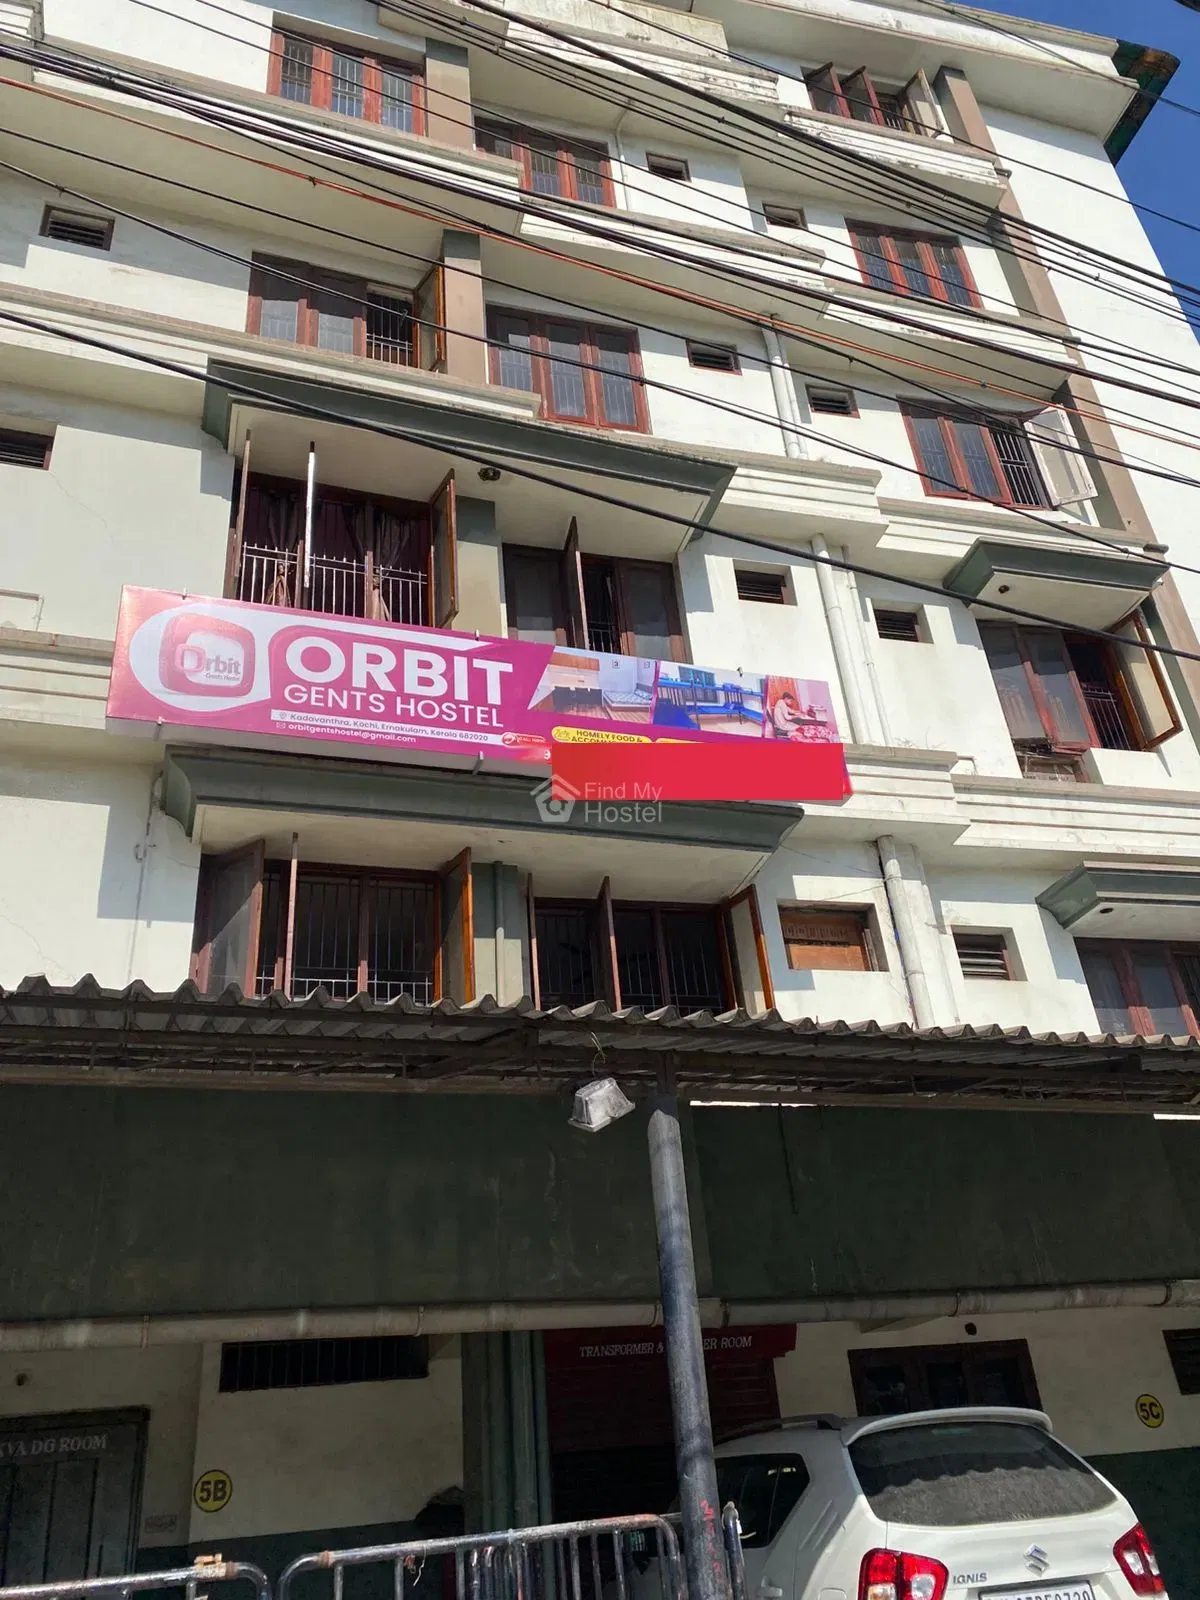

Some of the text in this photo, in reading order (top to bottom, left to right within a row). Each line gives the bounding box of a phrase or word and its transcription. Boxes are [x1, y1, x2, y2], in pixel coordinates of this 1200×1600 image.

[175, 644, 241, 675] Orbit
[285, 636, 513, 705] ORBIT
[284, 684, 504, 728] GENTS HOSTEL
[288, 724, 417, 743] orbitgentshostel@gmail.com
[290, 713, 489, 742] Kadavanthra, Kochi, Ernakulam, Kerala 682020
[576, 729, 610, 739] HOMELY
[611, 733, 636, 743] FOOD
[579, 1342, 654, 1358] TRANSFORMER
[656, 1341, 664, 1353] &
[720, 1335, 752, 1349] ROOM
[1139, 1402, 1160, 1420] 5C
[31, 1437, 56, 1455] DG
[59, 1433, 108, 1453] ROOM
[199, 1480, 227, 1503] 5B
[953, 1572, 988, 1585] IGNIS
